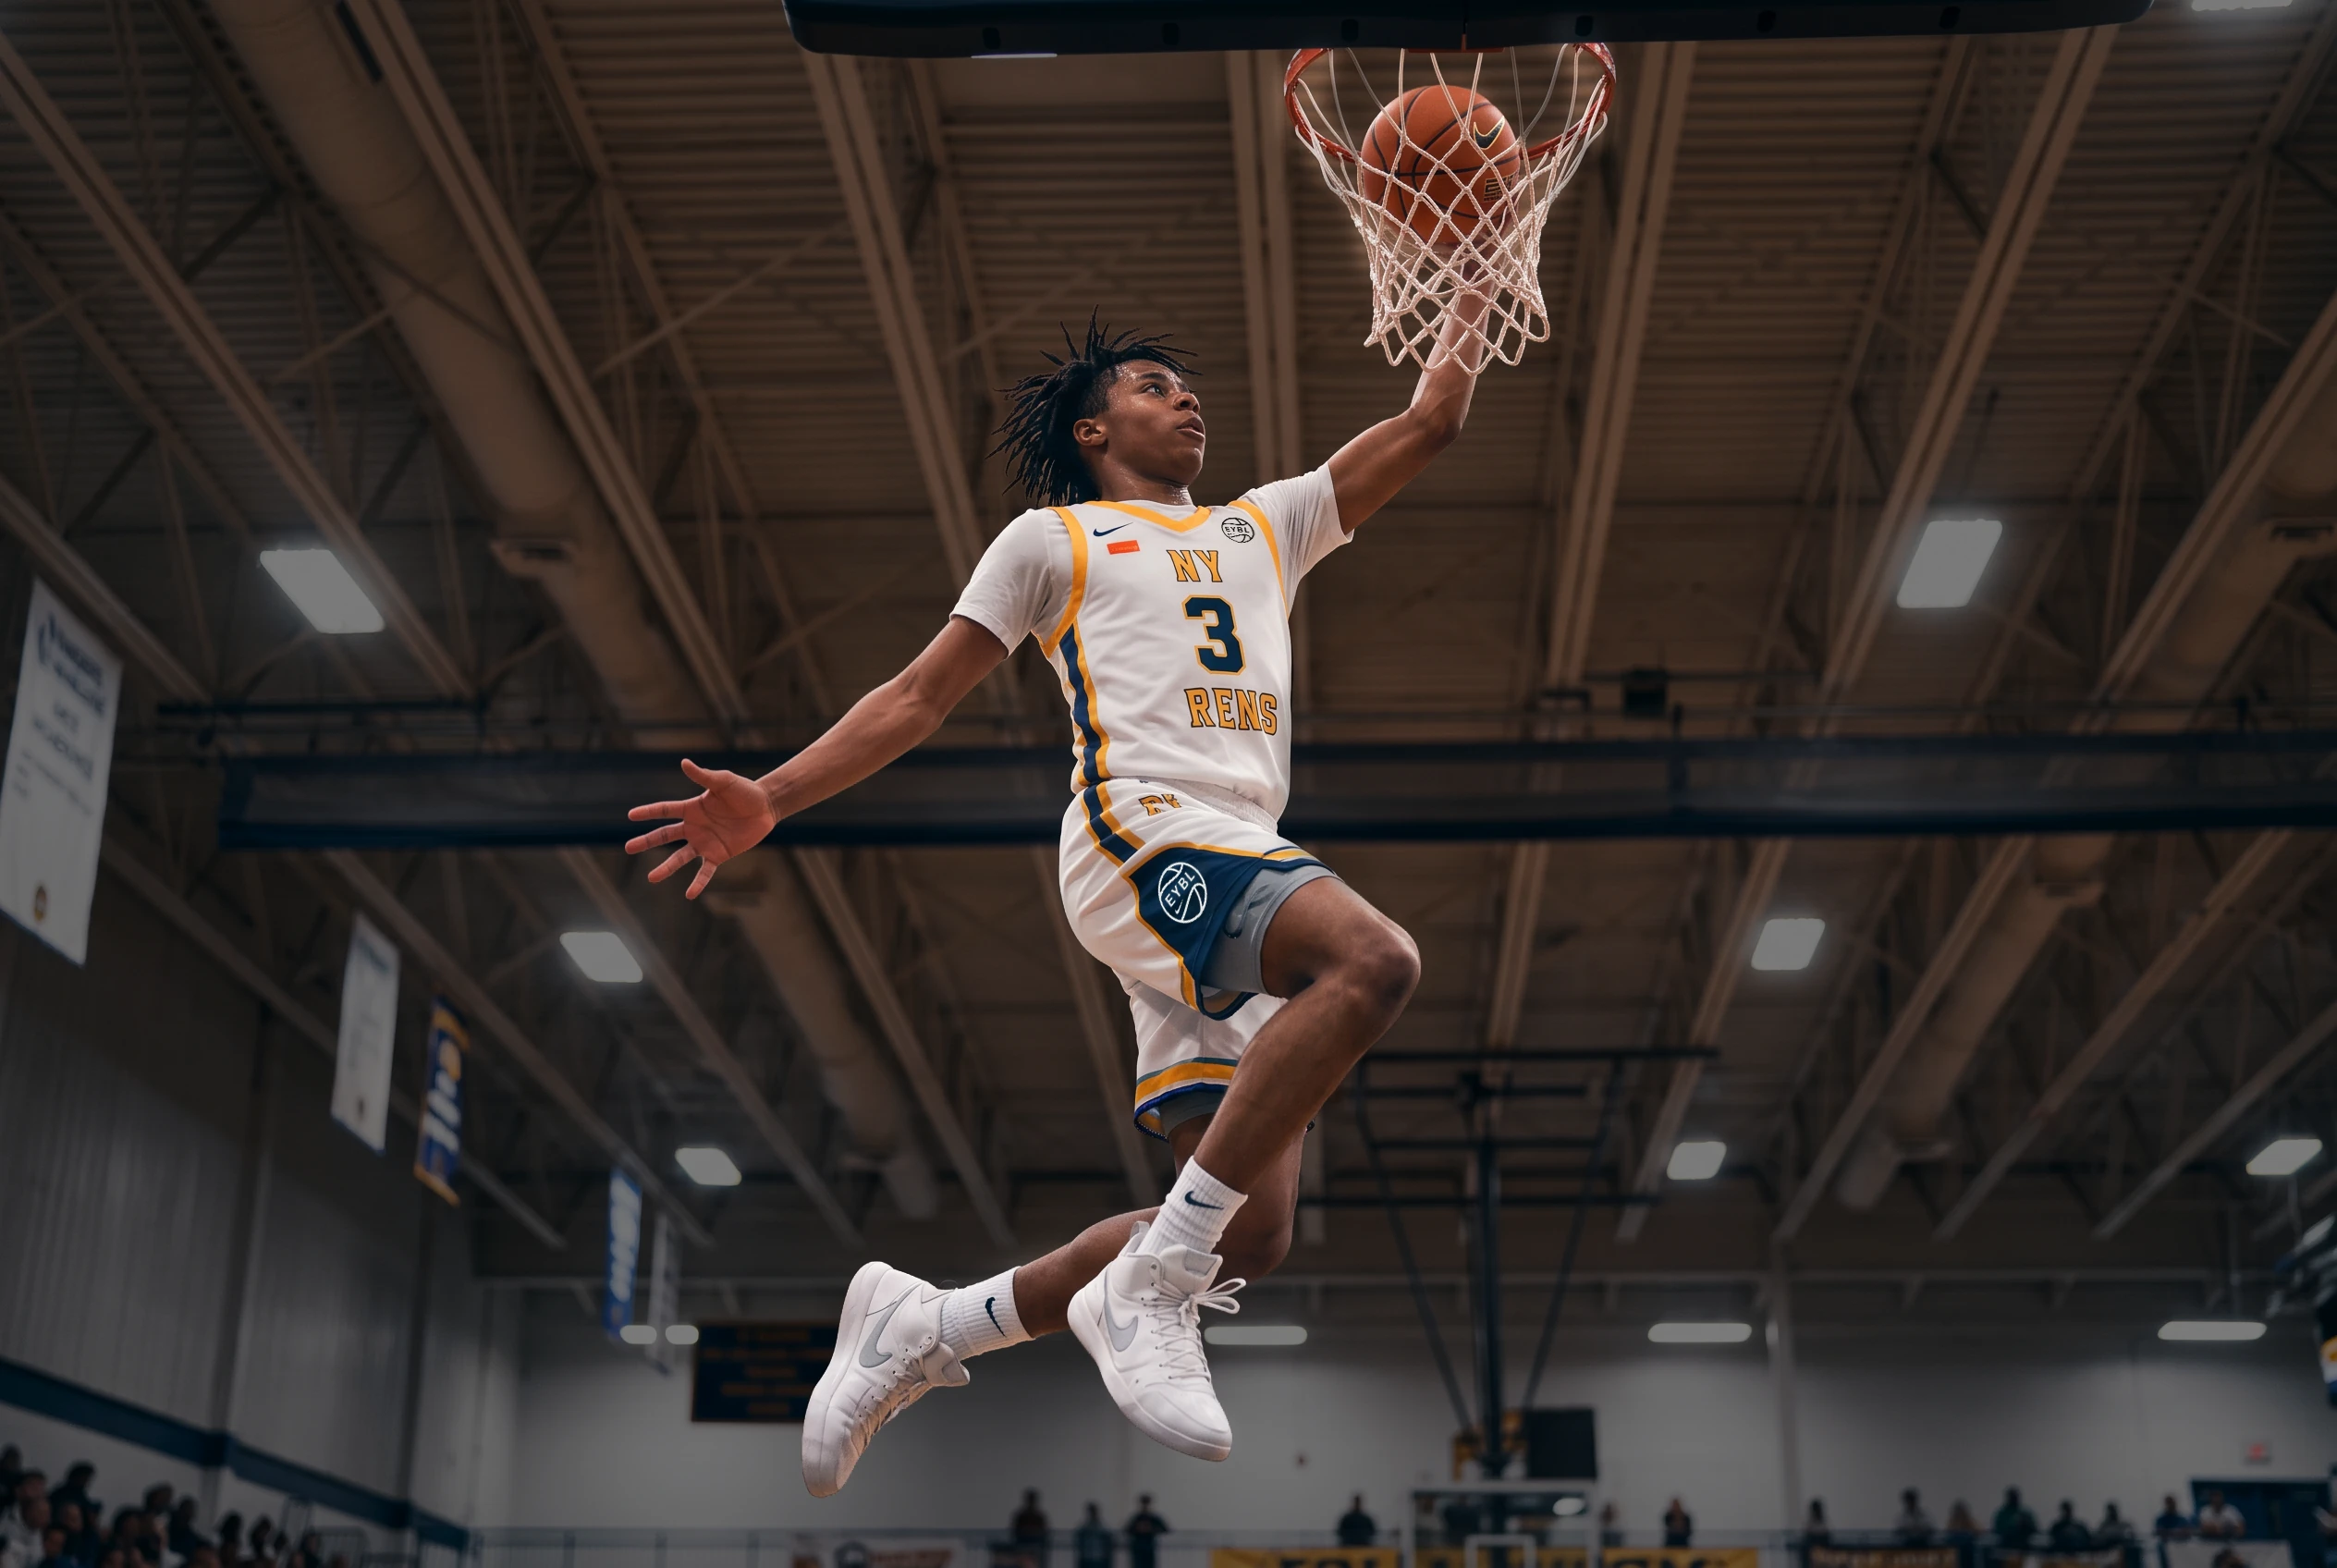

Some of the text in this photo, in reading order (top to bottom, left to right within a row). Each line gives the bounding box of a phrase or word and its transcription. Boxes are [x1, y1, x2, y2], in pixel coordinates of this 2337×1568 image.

[1166, 549, 1223, 583] NY
[1181, 594, 1246, 676] 3
[1183, 687, 1278, 736] RENS
[1164, 872, 1196, 908] EYBL
